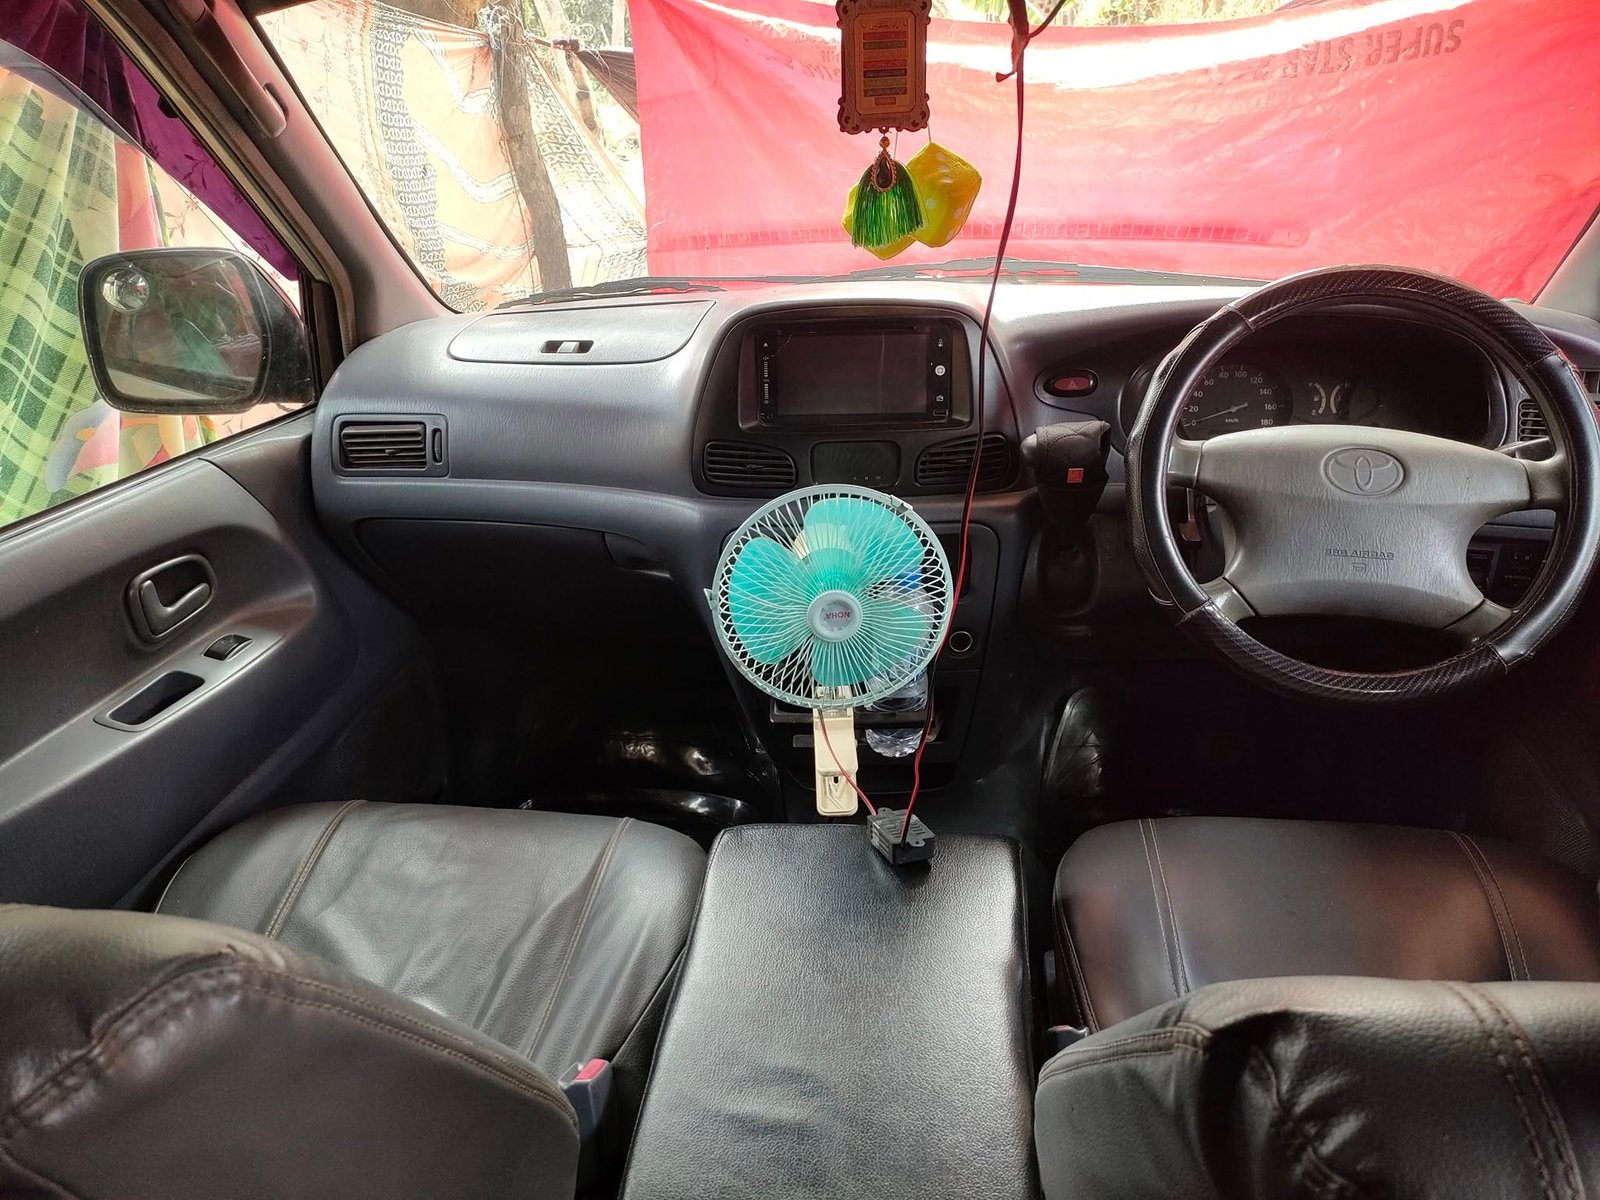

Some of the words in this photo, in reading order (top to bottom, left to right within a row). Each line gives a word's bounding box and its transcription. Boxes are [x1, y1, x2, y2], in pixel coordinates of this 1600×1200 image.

[1364, 19, 1465, 66] SUPER
[1218, 371, 1229, 379] 80
[1234, 370, 1248, 379] 100
[1203, 378, 1215, 386] 60
[1250, 376, 1263, 385] 120
[1192, 390, 1204, 398] 40
[1259, 388, 1272, 396] 140
[1188, 405, 1199, 413] 20
[1264, 403, 1277, 411] 160
[1260, 418, 1274, 426] 180
[825, 611, 850, 619] NOHA
